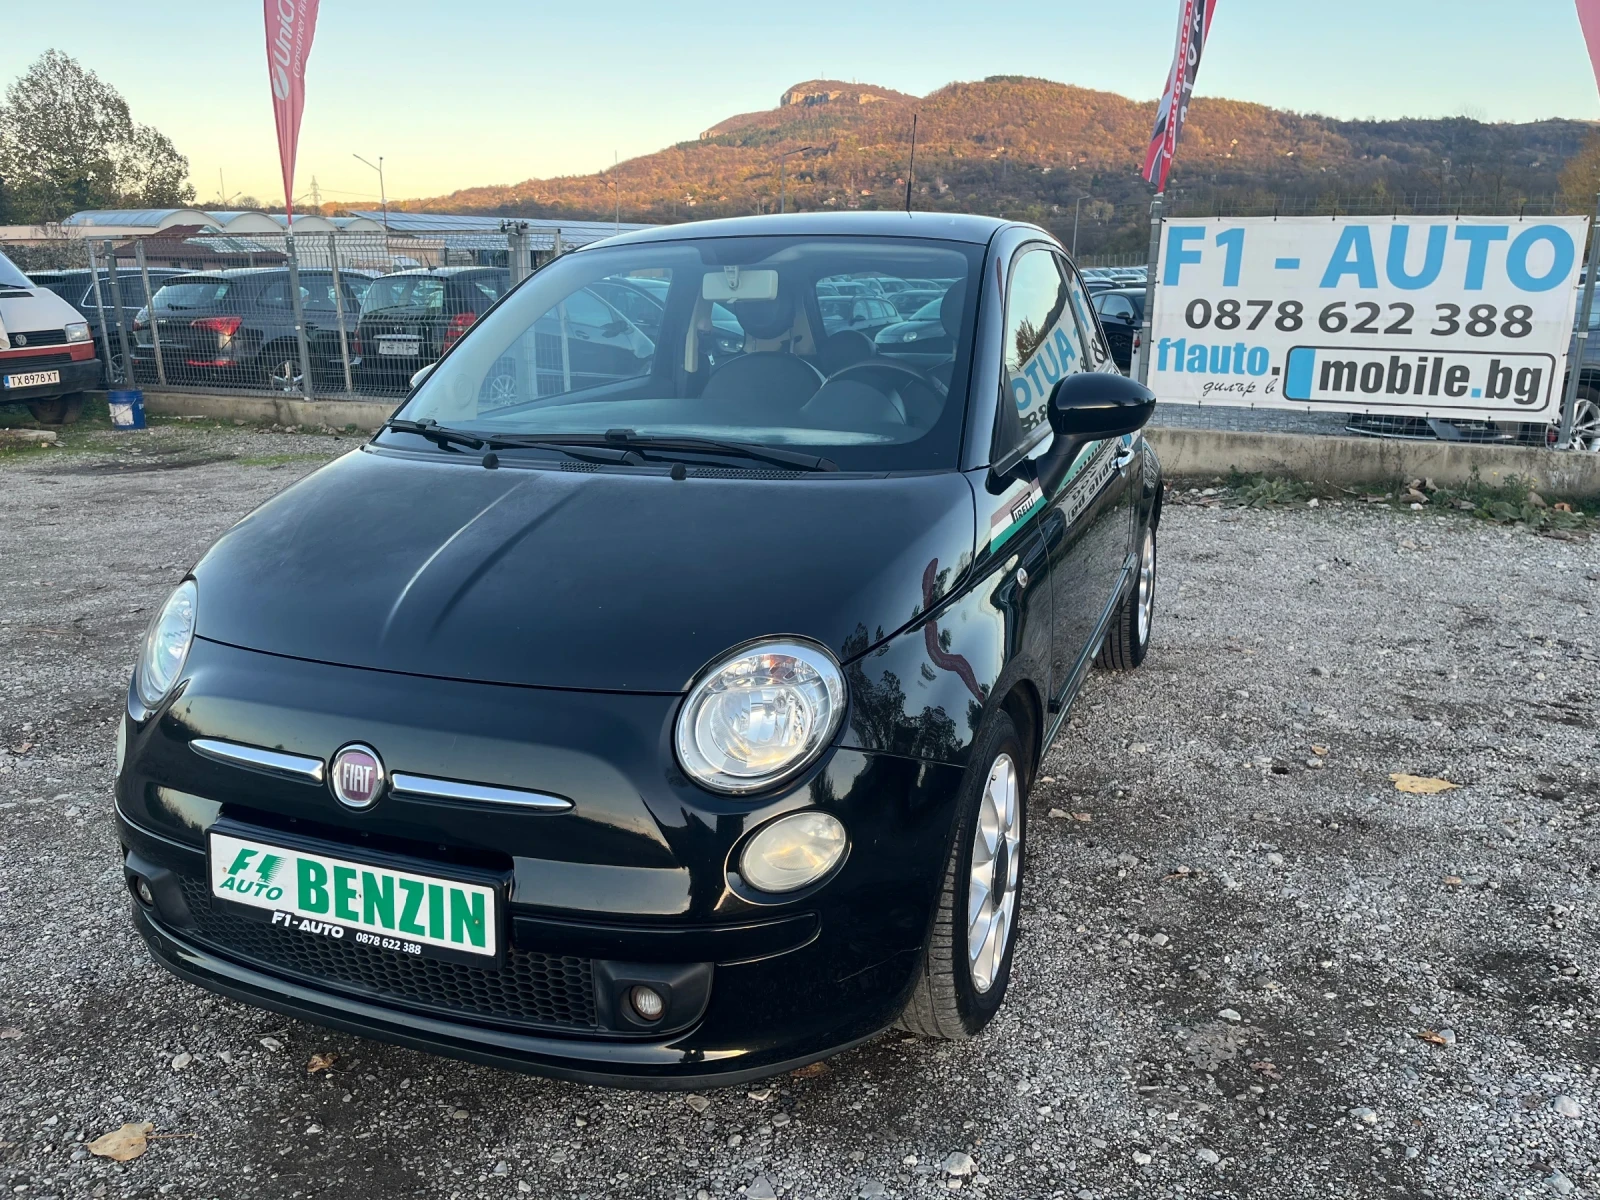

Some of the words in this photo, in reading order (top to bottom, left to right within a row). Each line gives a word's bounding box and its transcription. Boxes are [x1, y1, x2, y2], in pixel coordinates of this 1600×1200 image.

[293, 16, 305, 78] Consumer
[1163, 226, 1245, 287] F1
[1319, 224, 1575, 292] AUTO
[1185, 298, 1303, 332] 0878
[1318, 301, 1415, 335] 622
[1430, 303, 1533, 338] 388
[10, 375, 23, 387] TX
[24, 373, 46, 385] 8978
[46, 371, 57, 382] XT
[1318, 355, 1543, 405] mobile.bg
[342, 762, 373, 793] FIAT
[227, 848, 287, 883] F1
[219, 876, 283, 901] AUTO
[296, 857, 486, 948] BENZIN
[271, 910, 344, 939] F1-AUTO
[355, 932, 381, 946] 0878
[382, 937, 401, 951] 622
[402, 942, 422, 955] 388
